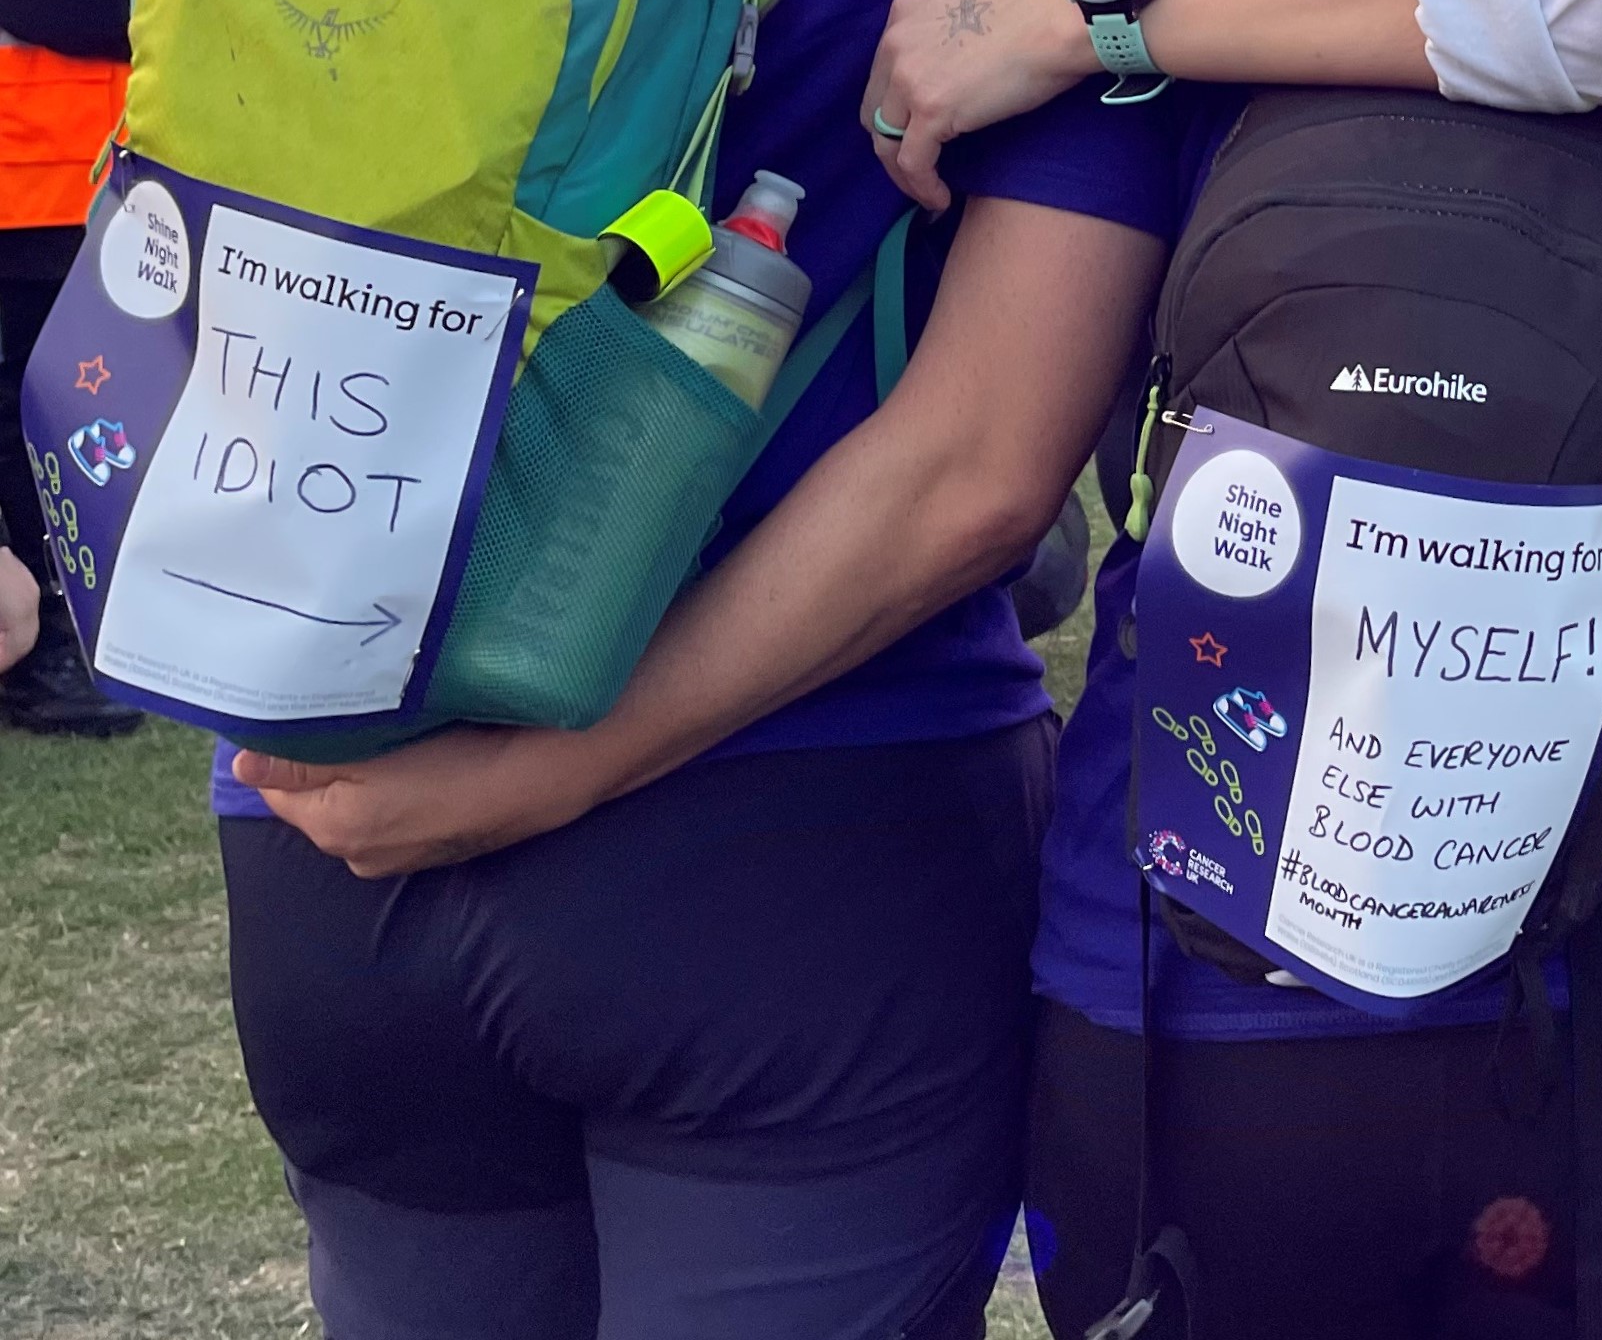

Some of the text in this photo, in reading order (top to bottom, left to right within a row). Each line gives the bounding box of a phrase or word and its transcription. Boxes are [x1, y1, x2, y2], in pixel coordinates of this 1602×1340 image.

[148, 212, 179, 244] Shine
[144, 237, 179, 270] Night
[137, 260, 178, 294] Walk
[218, 245, 483, 336] I'm walking for
[211, 327, 390, 437] THIS
[1373, 367, 1488, 403] Eurohike
[193, 432, 422, 533] IDIOT
[1225, 483, 1283, 520] Shine
[1217, 511, 1278, 547] Night
[1213, 536, 1273, 573] Walk
[1346, 518, 1406, 560] I'm
[1417, 534, 1565, 582] walking
[1355, 606, 1597, 684] MYSELF!
[1329, 717, 1570, 770] AND EVERYONE
[1321, 766, 1500, 820] ELSE WITH
[1309, 805, 1553, 870] BLOOD CANCER
[1186, 869, 1199, 884] UK
[1187, 858, 1234, 895] RESEARCH
[1189, 849, 1226, 878] CANCER
[1300, 892, 1362, 930] MONTH
